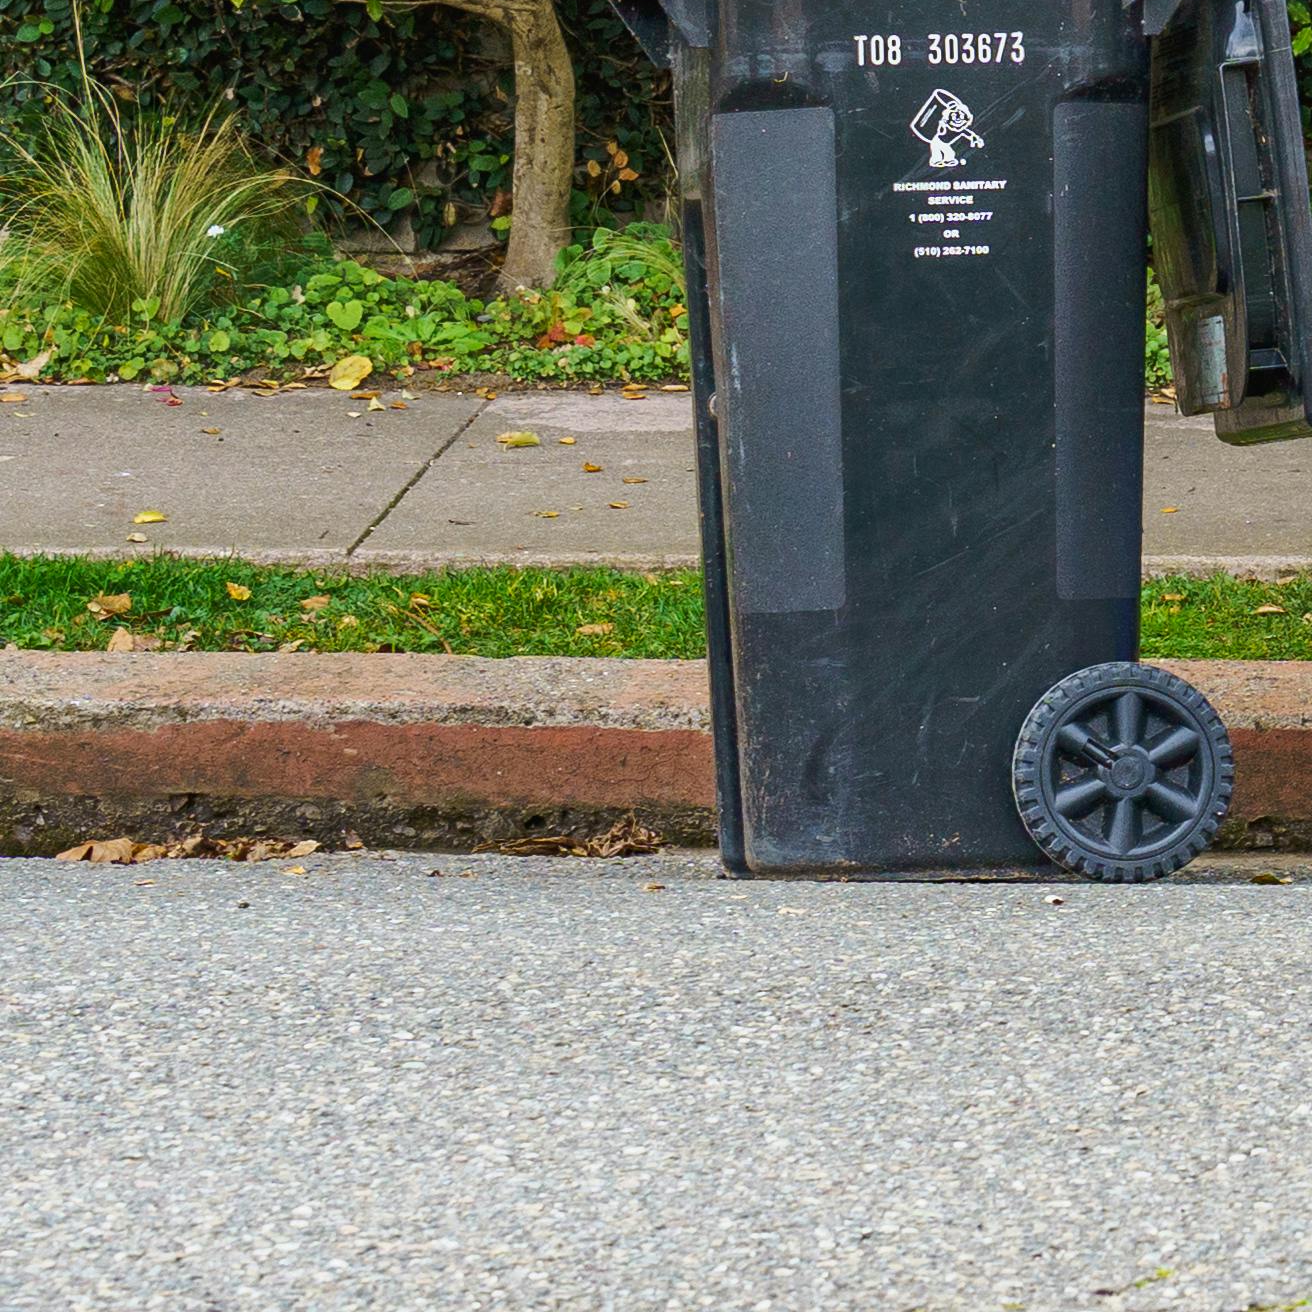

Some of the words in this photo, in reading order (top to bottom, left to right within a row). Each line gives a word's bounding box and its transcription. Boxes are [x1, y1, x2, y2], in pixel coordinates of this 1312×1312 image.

[853, 34, 902, 66] T08
[927, 31, 1026, 65] 303673
[893, 181, 952, 192] RICHMOND
[952, 180, 1007, 191] SANITARY
[927, 195, 974, 205] SERVICE
[908, 213, 916, 223] 1
[918, 212, 945, 224] (800)
[946, 211, 993, 222] 320-8077
[943, 229, 960, 238] OR
[913, 246, 941, 258] (510)
